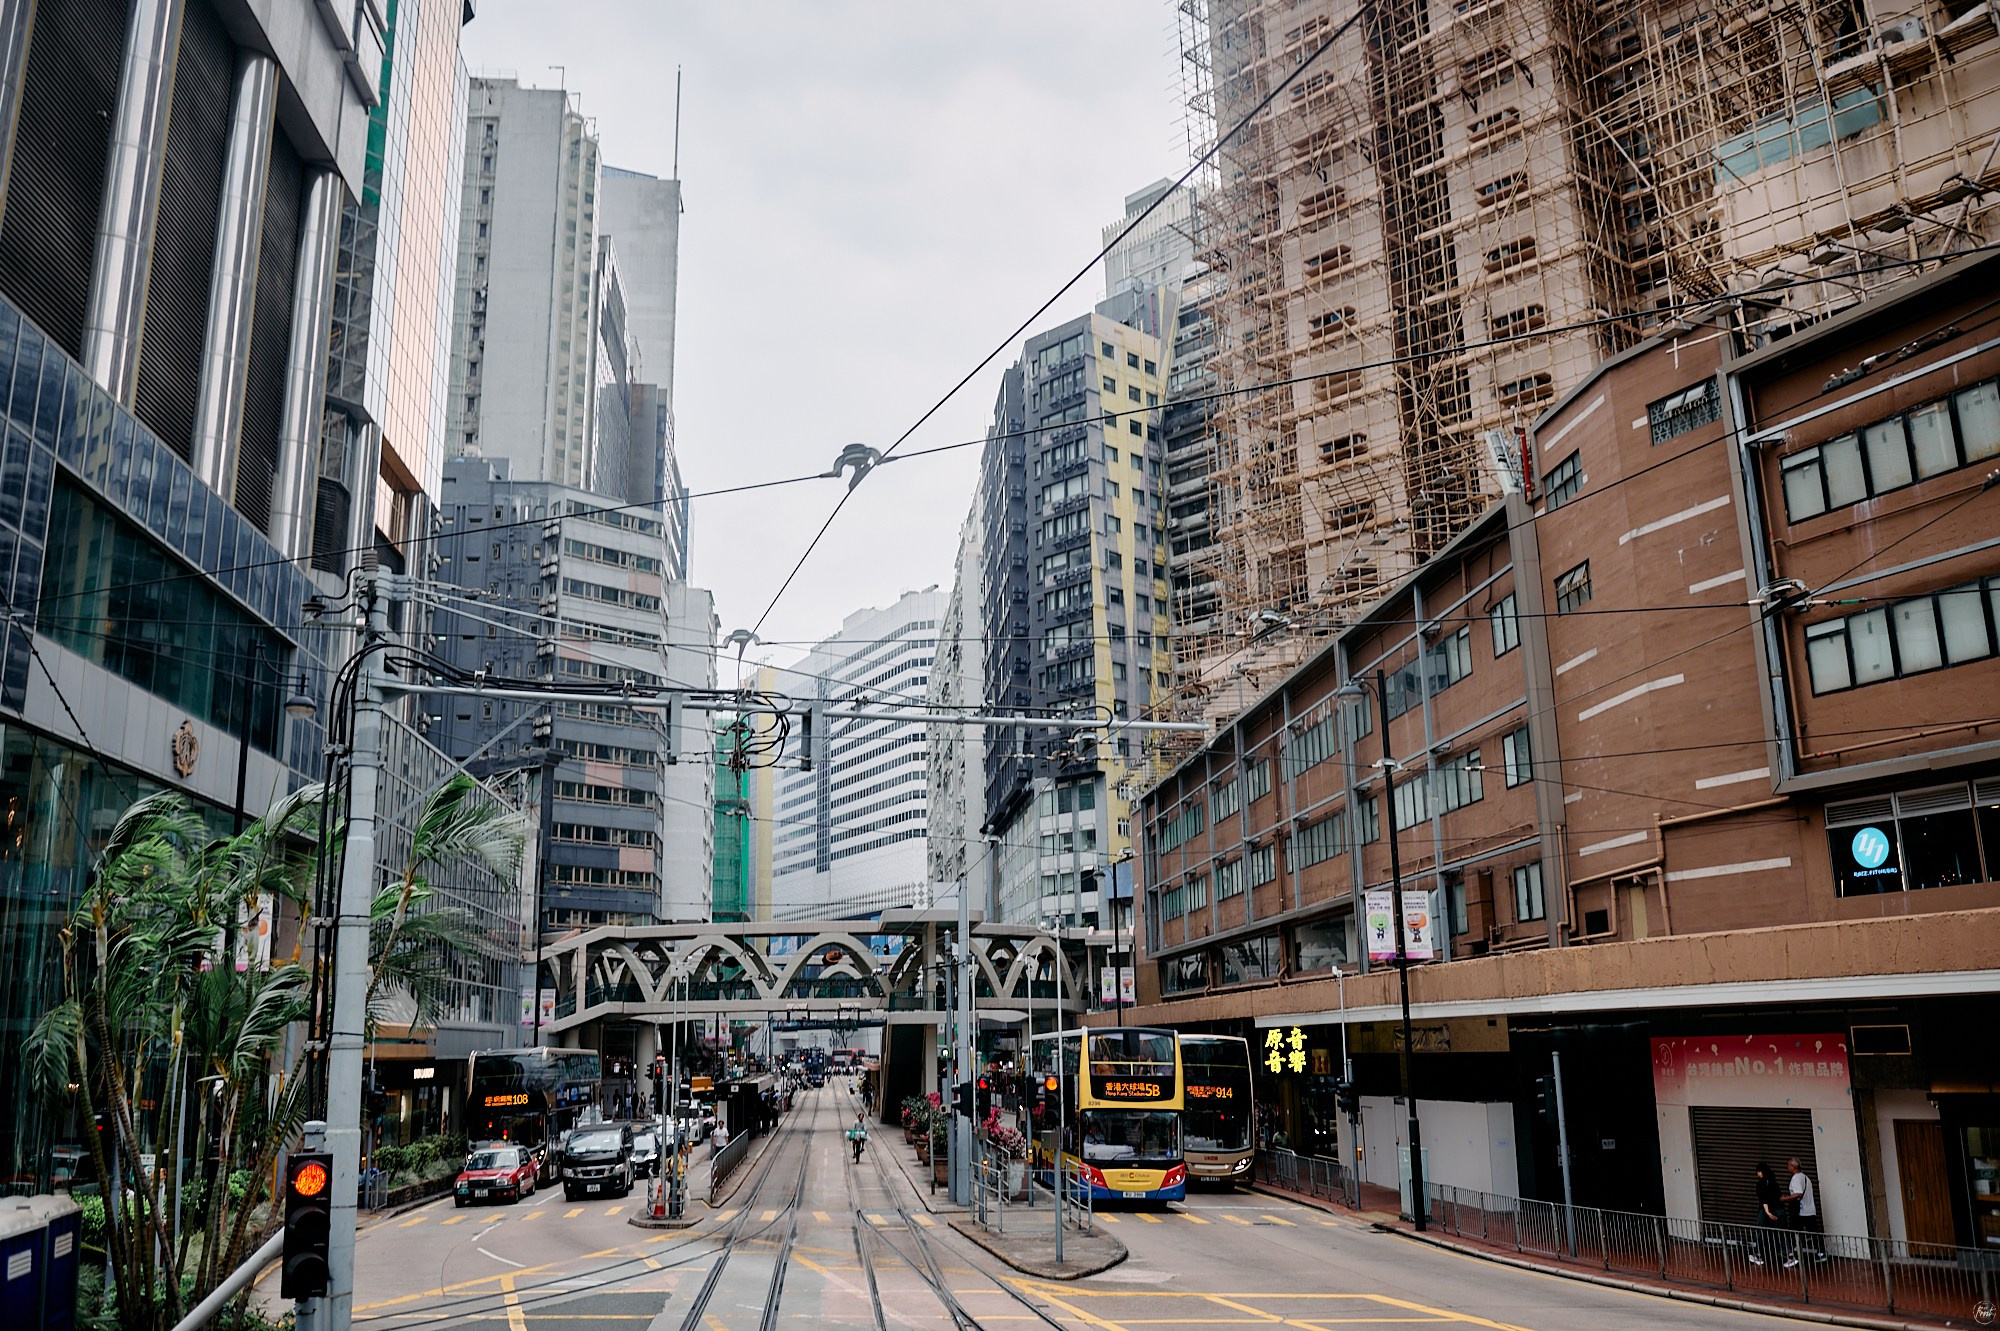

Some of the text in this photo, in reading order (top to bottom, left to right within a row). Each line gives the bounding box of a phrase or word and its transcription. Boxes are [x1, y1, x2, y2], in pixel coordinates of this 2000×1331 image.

[1145, 1083, 1160, 1097] 5B
[1216, 1087, 1233, 1098] 914
[512, 1094, 529, 1105] 108
